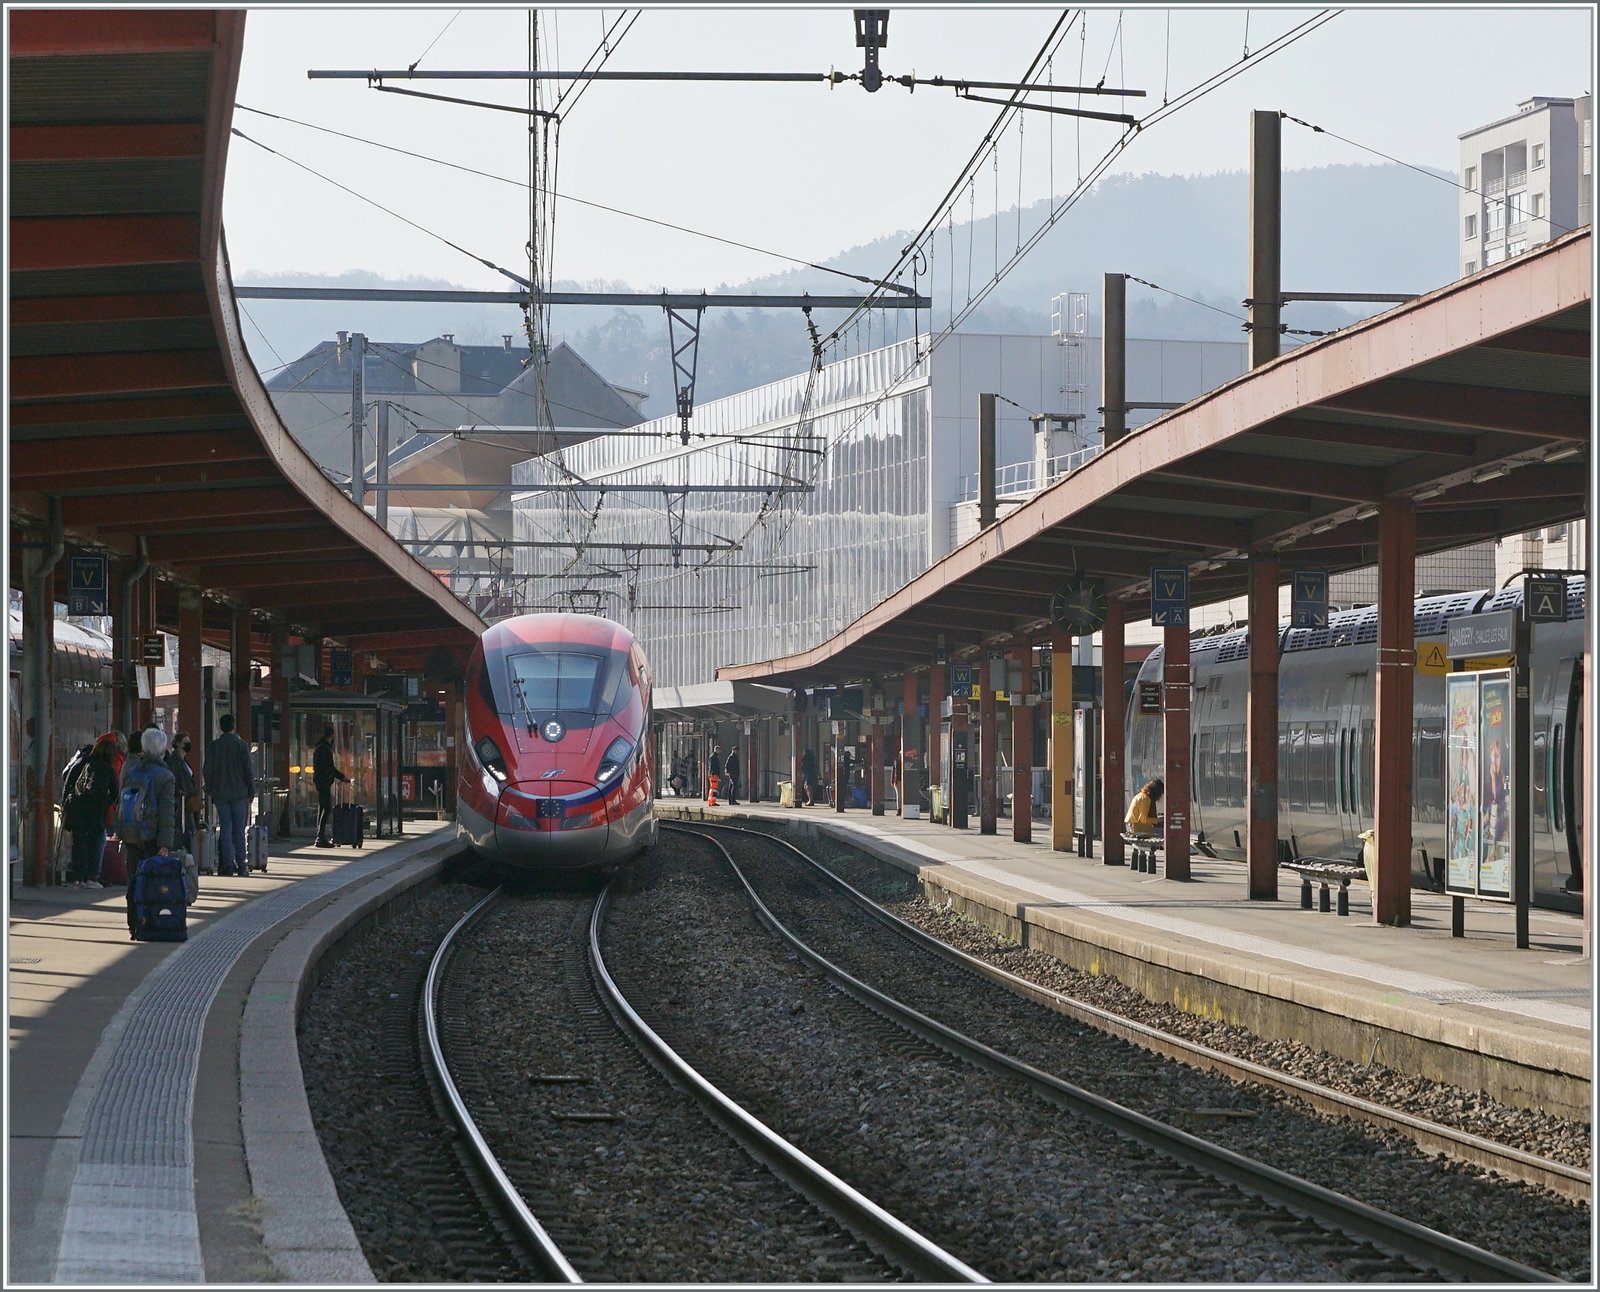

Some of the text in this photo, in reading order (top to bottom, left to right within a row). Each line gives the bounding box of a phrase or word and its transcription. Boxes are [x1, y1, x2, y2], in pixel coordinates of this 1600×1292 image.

[81, 571, 94, 585] V
[1164, 583, 1176, 597] V
[1304, 585, 1317, 599] V
[1539, 585, 1554, 593] Voie
[76, 602, 83, 611] B
[1538, 595, 1555, 613] A
[1174, 613, 1182, 622] A
[1300, 615, 1306, 624] 4
[1046, 656, 1051, 664] 4
[957, 673, 967, 681] W
